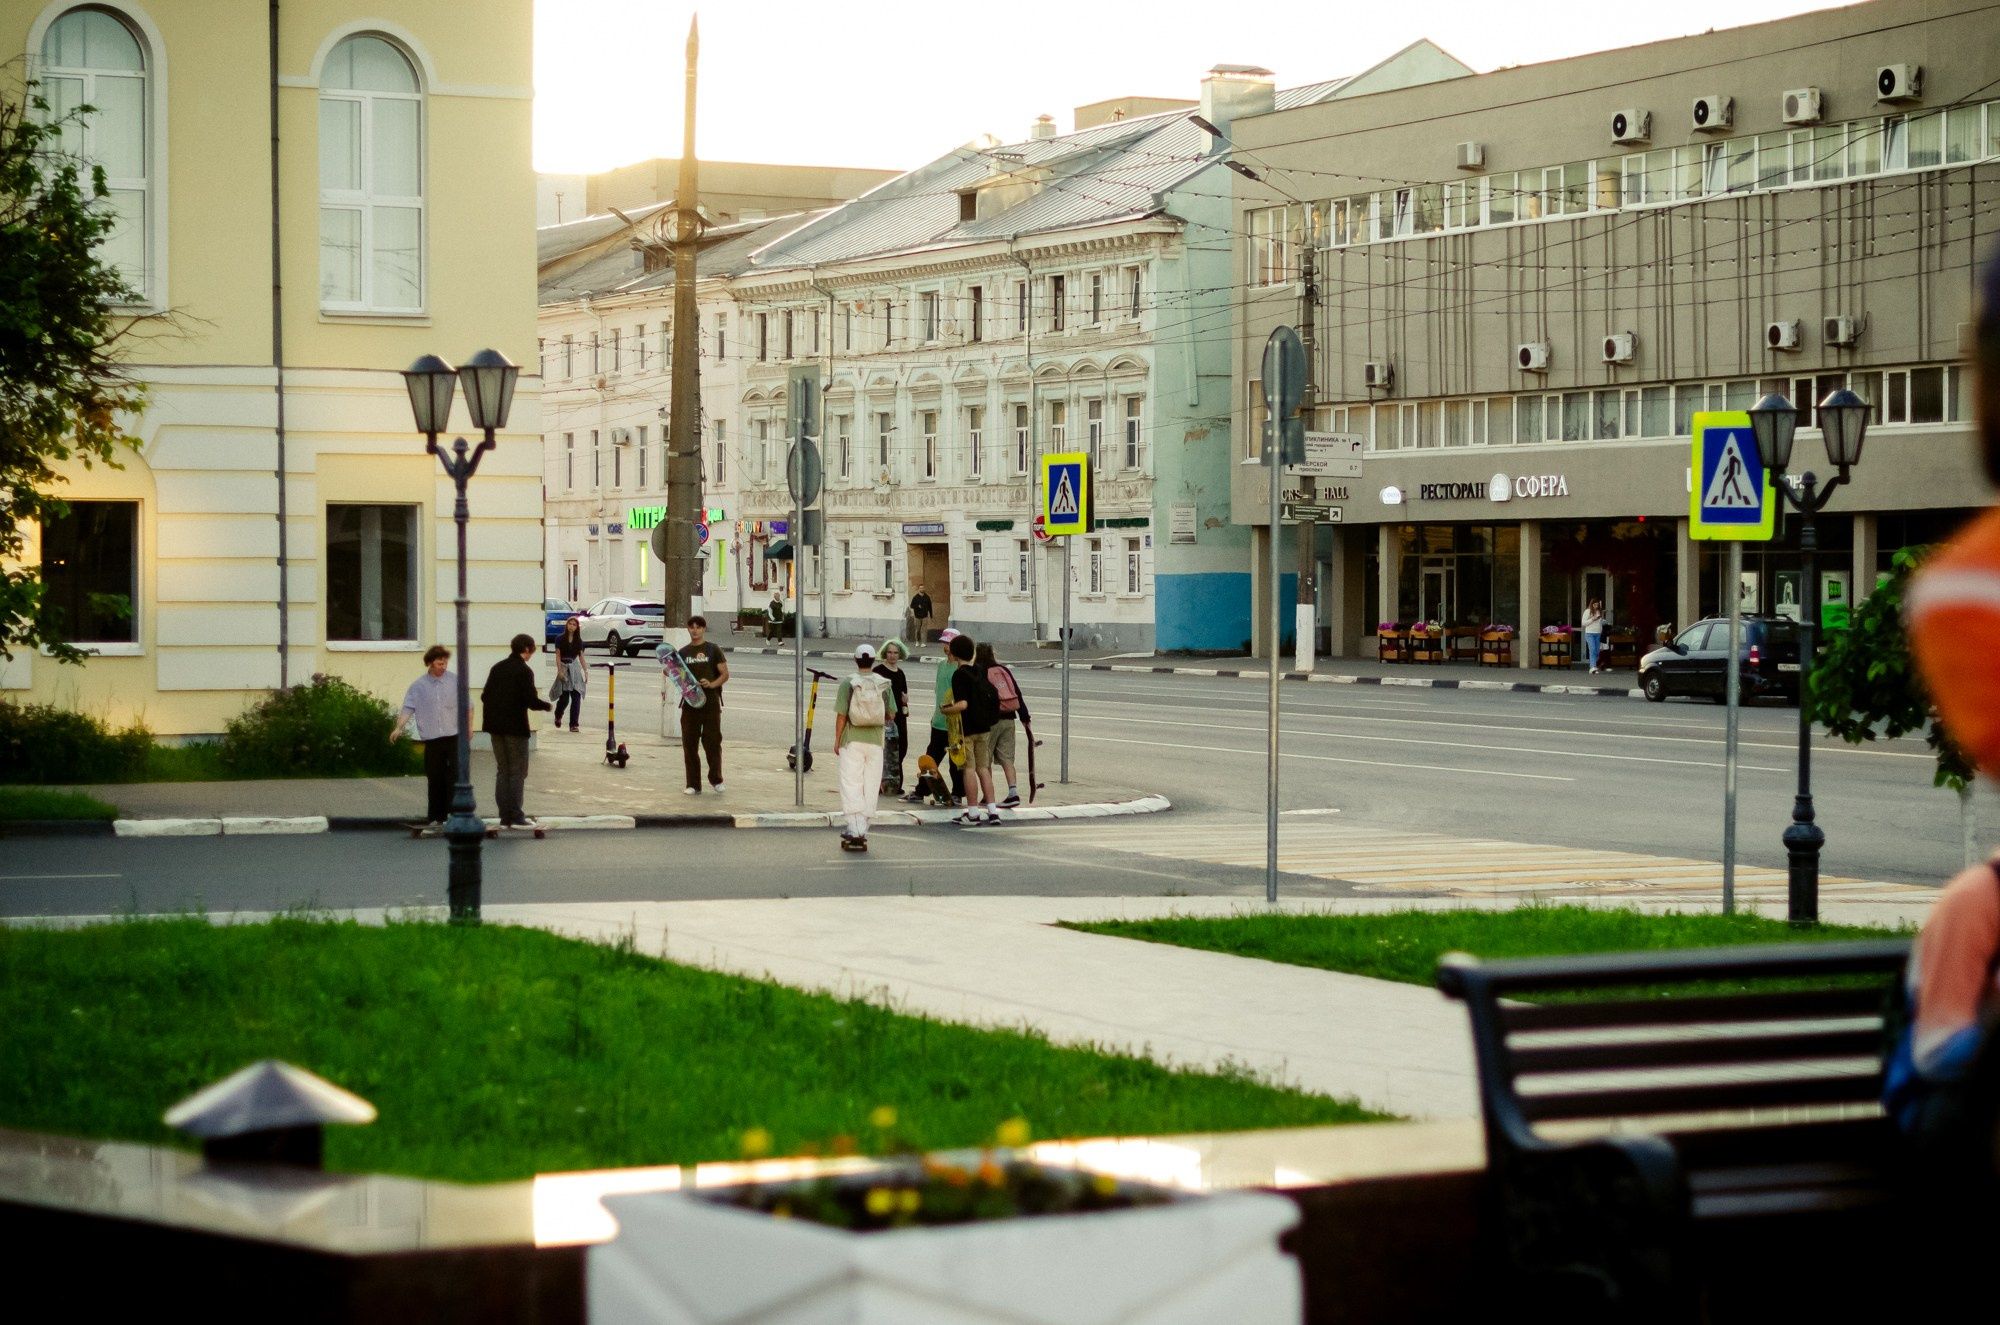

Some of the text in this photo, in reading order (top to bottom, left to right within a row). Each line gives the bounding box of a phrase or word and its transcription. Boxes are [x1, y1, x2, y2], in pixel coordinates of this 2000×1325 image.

[1324, 486, 1349, 500] HALL
[1421, 475, 1569, 500] РЕСТОРАН СФЕРА
[627, 506, 667, 529] АПТЕК
